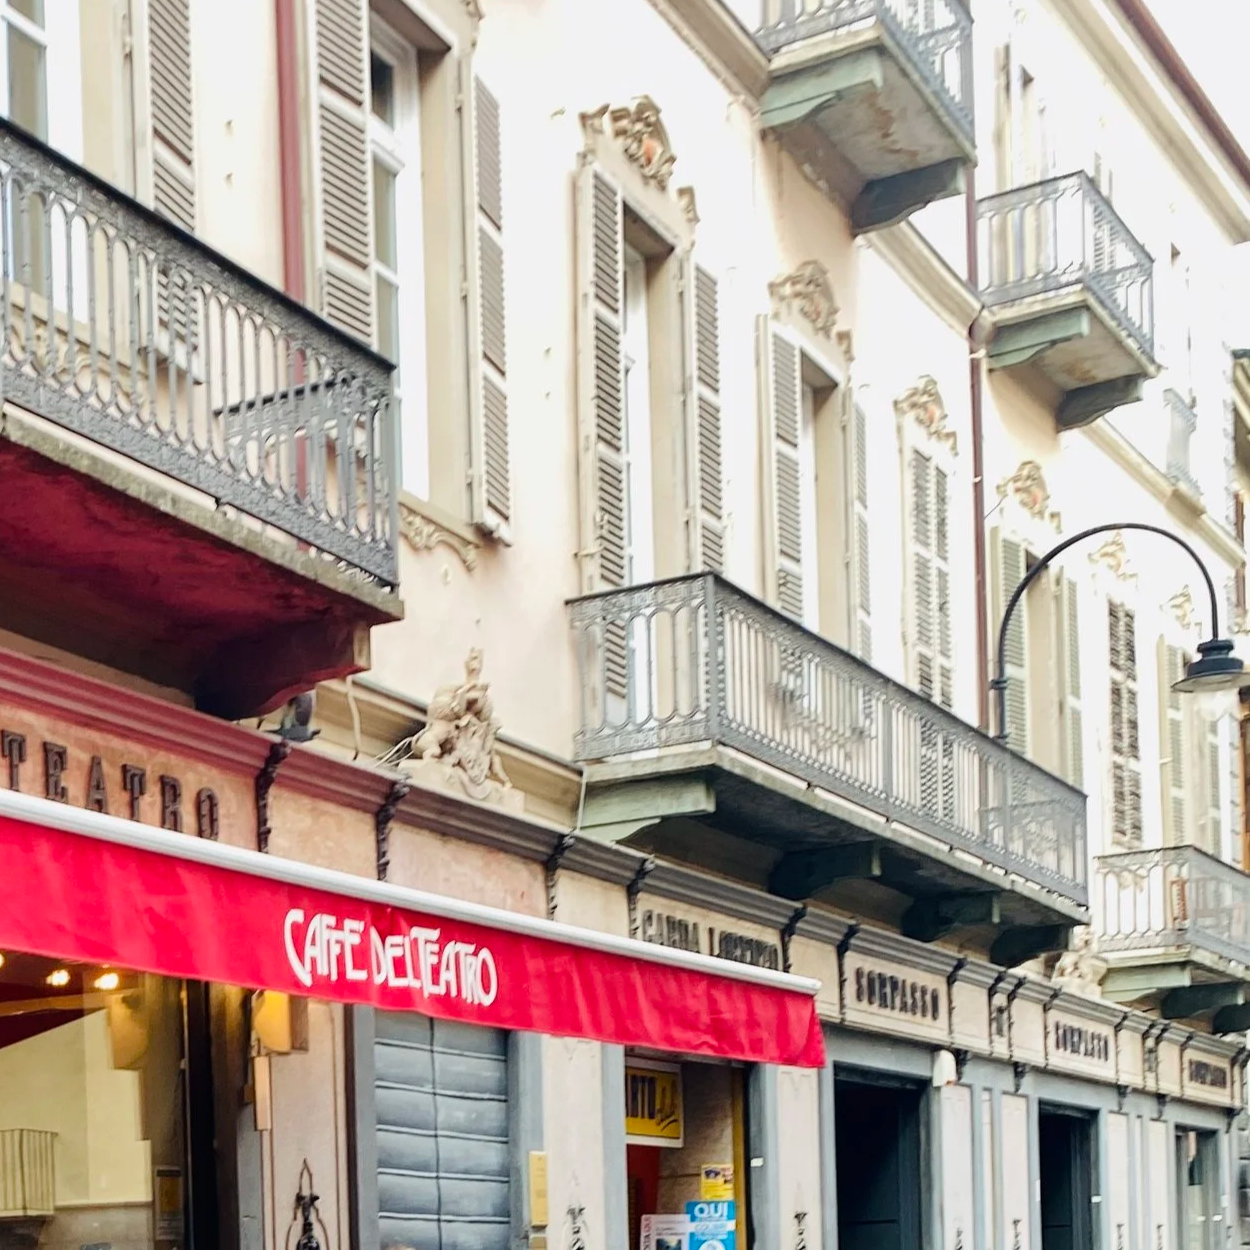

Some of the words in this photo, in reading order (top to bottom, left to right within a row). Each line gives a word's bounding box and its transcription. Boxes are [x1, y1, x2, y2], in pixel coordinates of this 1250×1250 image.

[0, 729, 220, 842] TEATRO
[369, 925, 423, 989] DEL
[410, 925, 498, 1007] TEATRO
[694, 1202, 729, 1218] QUI
